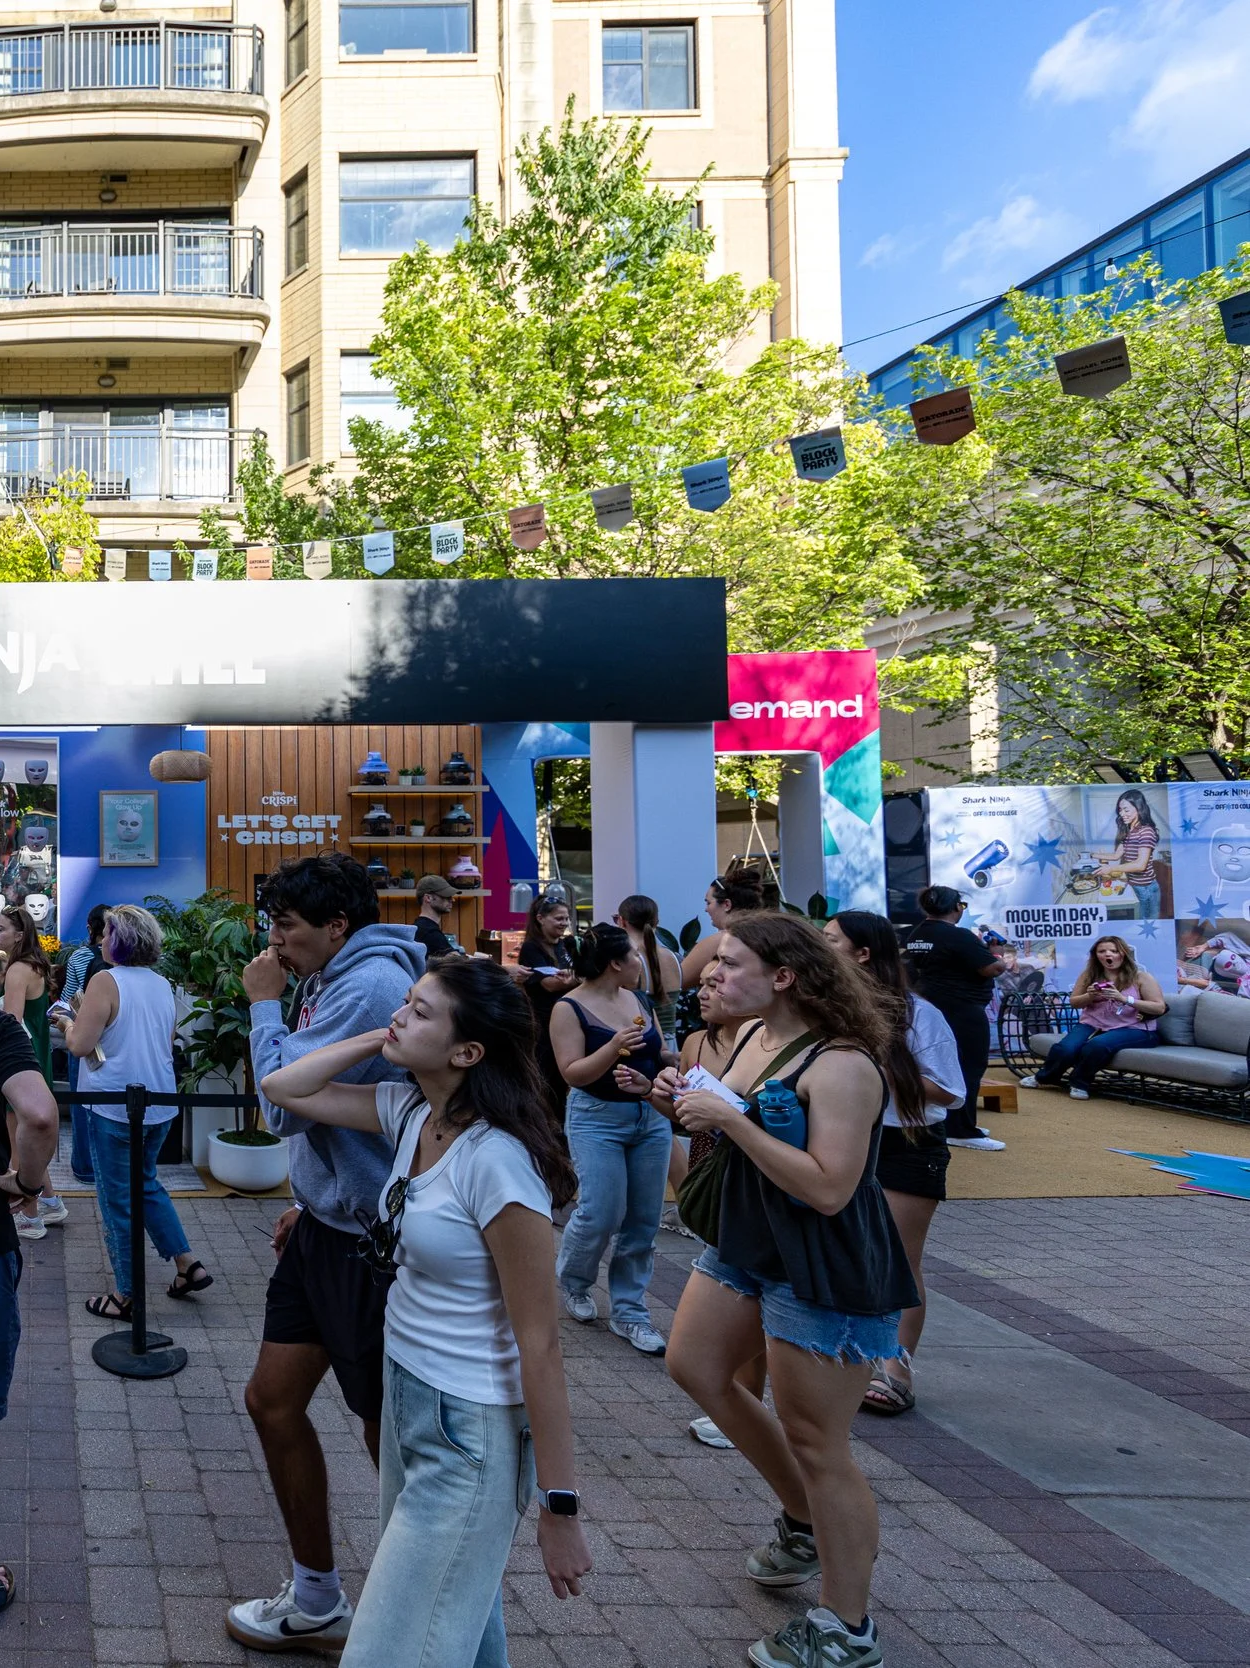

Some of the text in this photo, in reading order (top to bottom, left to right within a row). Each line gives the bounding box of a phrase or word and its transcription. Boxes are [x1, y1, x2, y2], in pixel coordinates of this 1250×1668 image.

[1101, 355, 1123, 365] KORS
[918, 406, 967, 423] GATORADE
[801, 447, 837, 462] BLOCK
[803, 456, 838, 472] PARTY
[513, 519, 542, 528] GATORADE
[436, 537, 458, 547] BLOCK
[436, 545, 458, 555] PARTY
[729, 694, 863, 719] emand
[990, 796, 1011, 804] NINJA
[1203, 789, 1229, 797] Shark
[217, 814, 341, 829] LET'S GET
[235, 830, 324, 845] CRISPI
[1006, 907, 1103, 923] MOVE IN DAY,
[1015, 923, 1092, 938] UPGRADED
